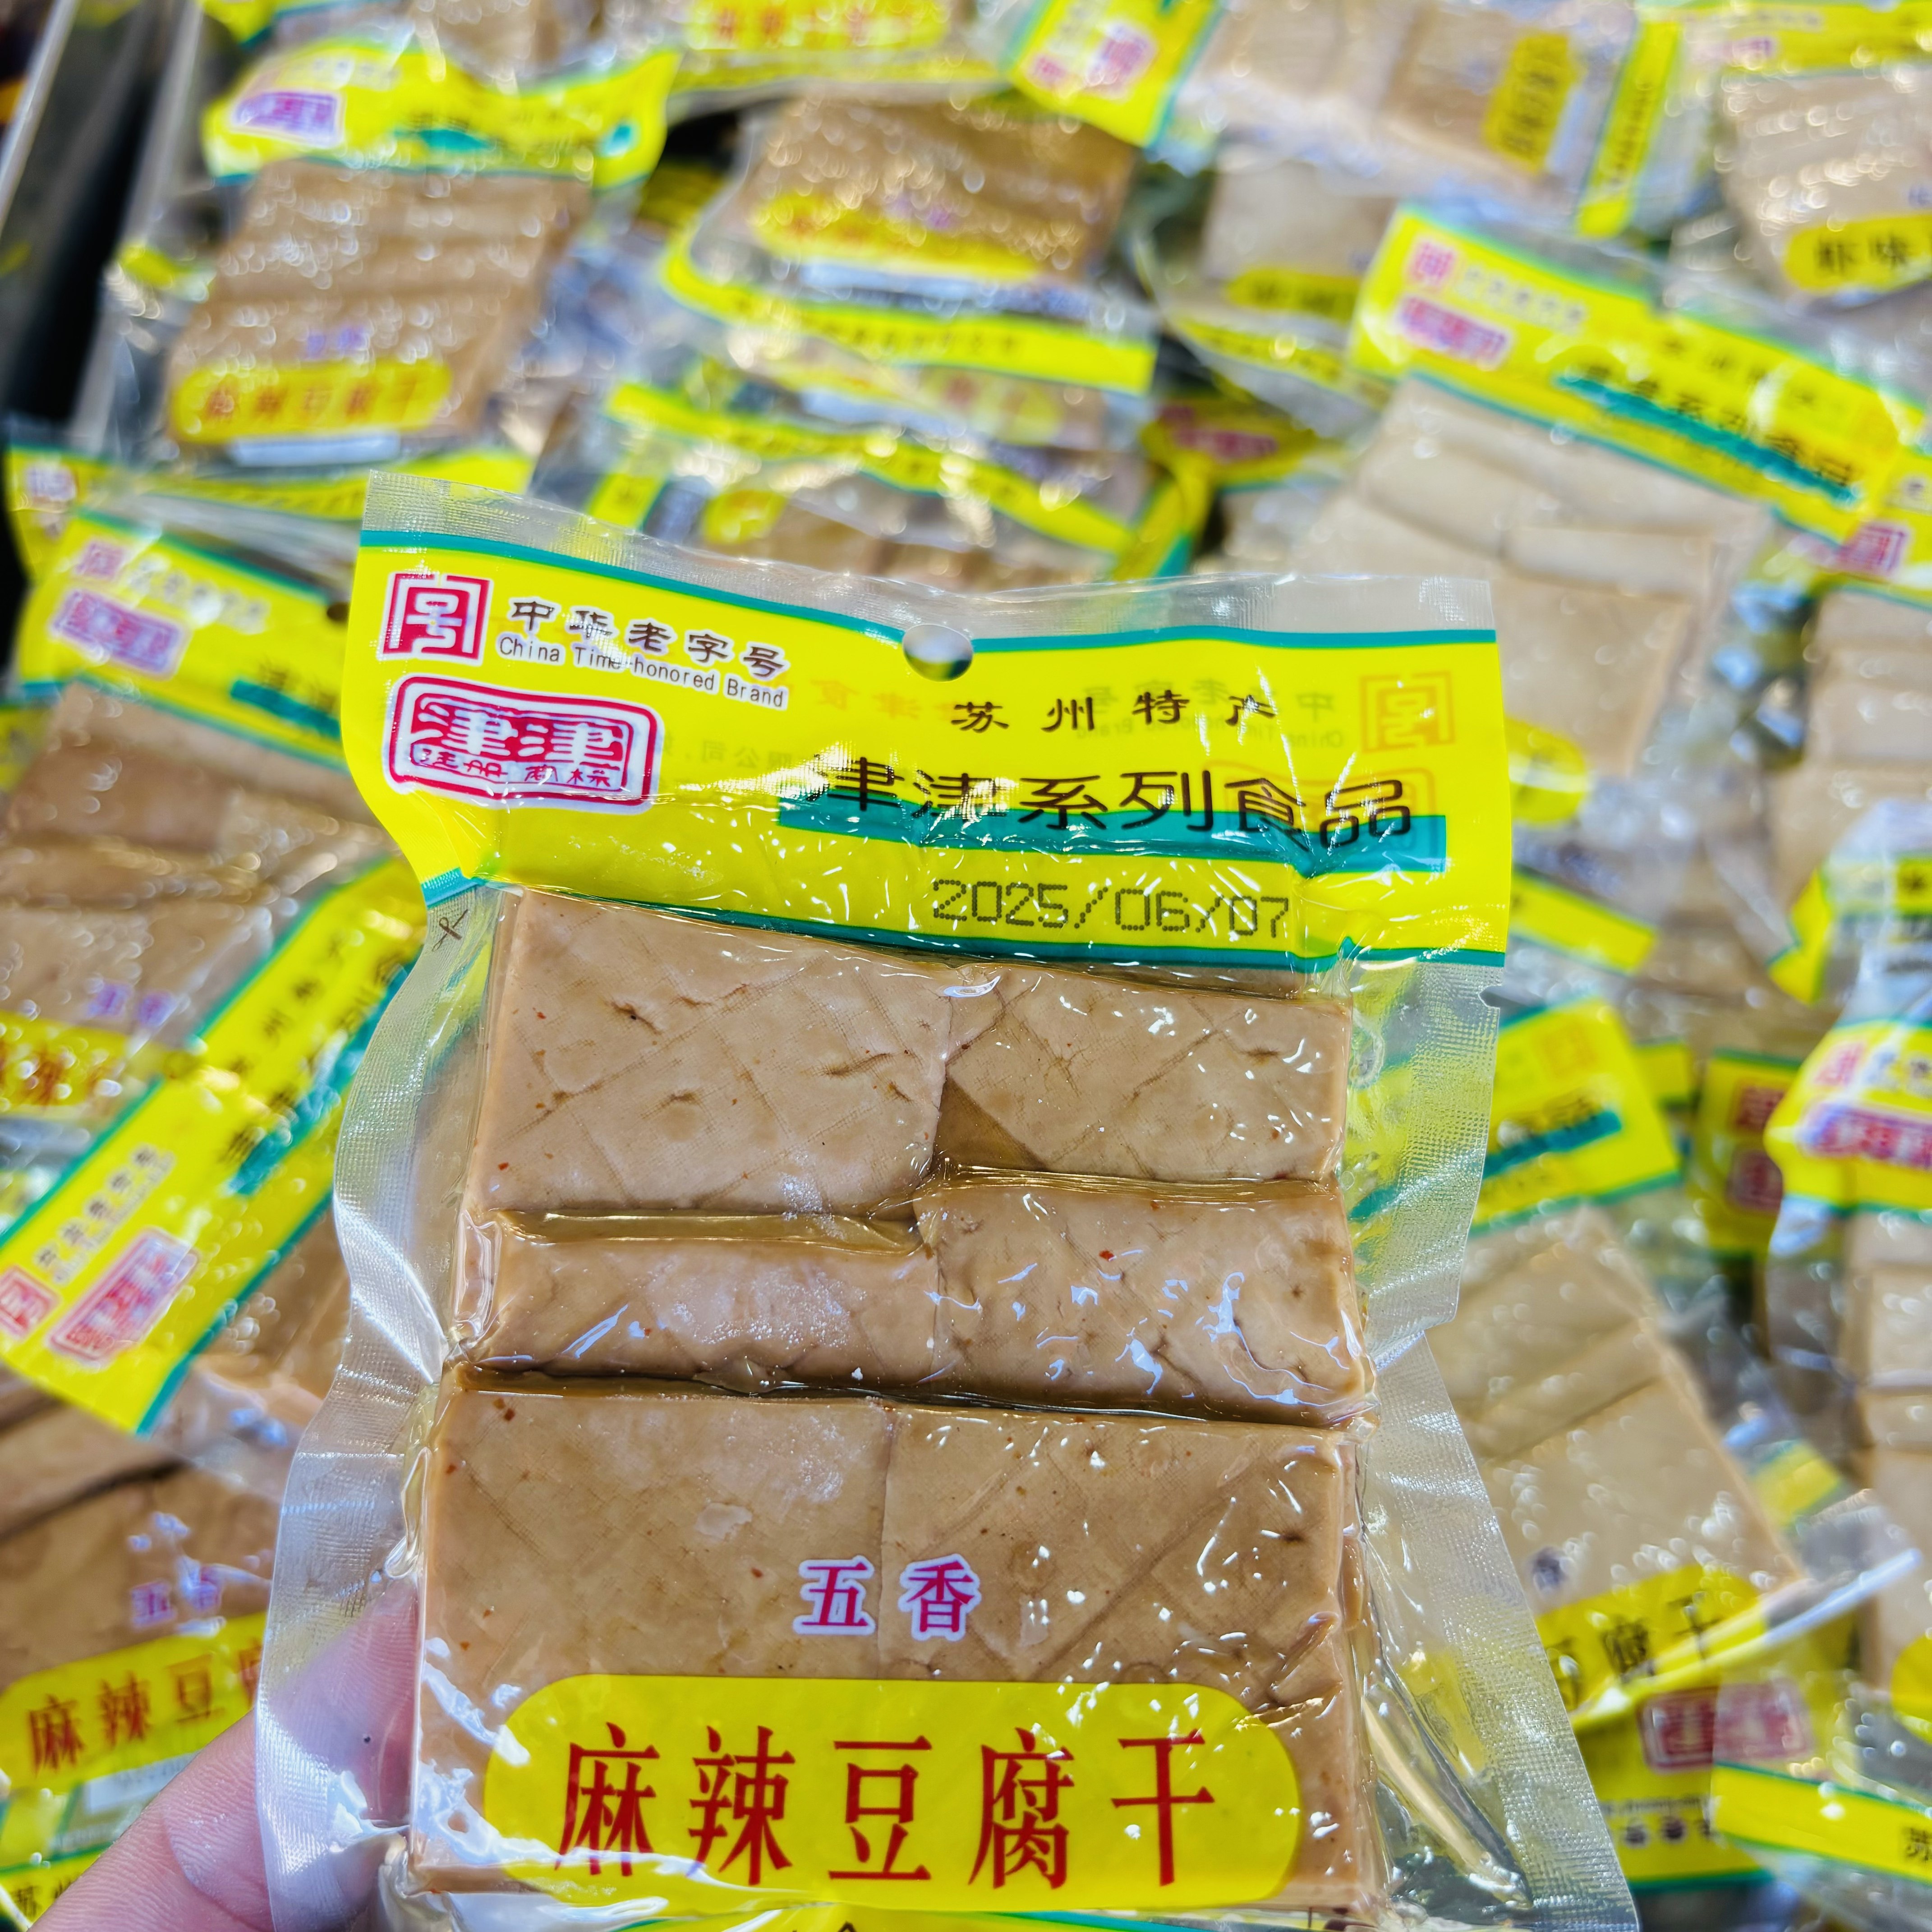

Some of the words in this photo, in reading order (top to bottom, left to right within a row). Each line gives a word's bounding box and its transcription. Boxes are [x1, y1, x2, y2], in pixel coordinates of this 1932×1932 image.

[499, 637, 560, 662] China
[575, 646, 714, 690] Time-honored
[727, 678, 783, 708] Brand
[511, 601, 784, 677] 中华老字号
[409, 696, 625, 764] 津津
[952, 690, 1278, 732] 苏州特产
[806, 756, 1411, 851] 津津系列食品
[933, 879, 1288, 938] 2025/06/07
[801, 1560, 975, 1633] 五香
[554, 1721, 1215, 1890] 麻辣豆腐干
